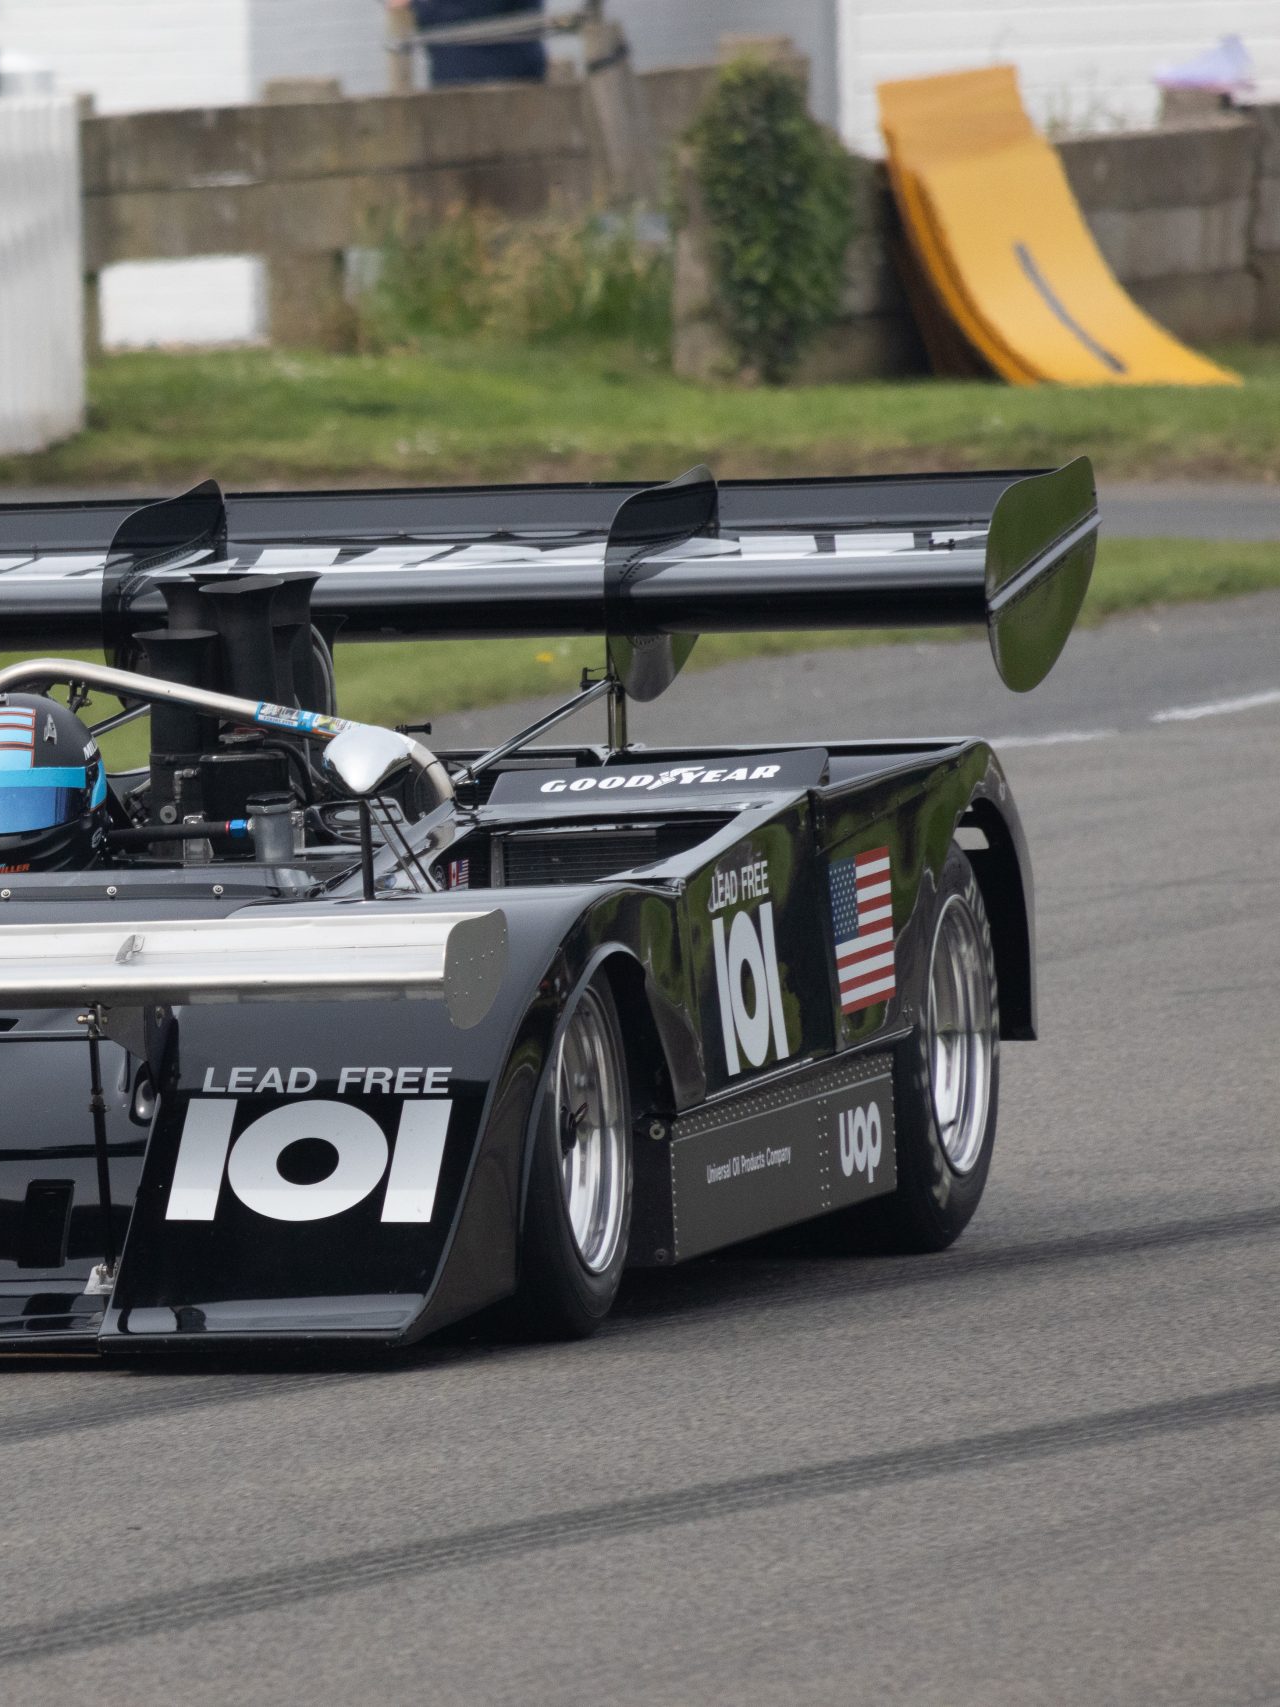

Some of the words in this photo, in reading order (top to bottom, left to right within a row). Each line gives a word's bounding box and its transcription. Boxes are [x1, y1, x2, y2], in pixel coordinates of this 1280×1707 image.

[540, 764, 782, 791] GOODYEAR
[711, 870, 738, 911] LEAD
[741, 860, 770, 901] FREE
[712, 901, 790, 1077] 101
[202, 1066, 318, 1094] LEAD
[337, 1066, 453, 1094] FREE
[164, 1098, 453, 1223] 101
[706, 1159, 732, 1184] Universal
[732, 1156, 740, 1177] Oil
[741, 1152, 765, 1174] Products
[766, 1146, 791, 1168] Company
